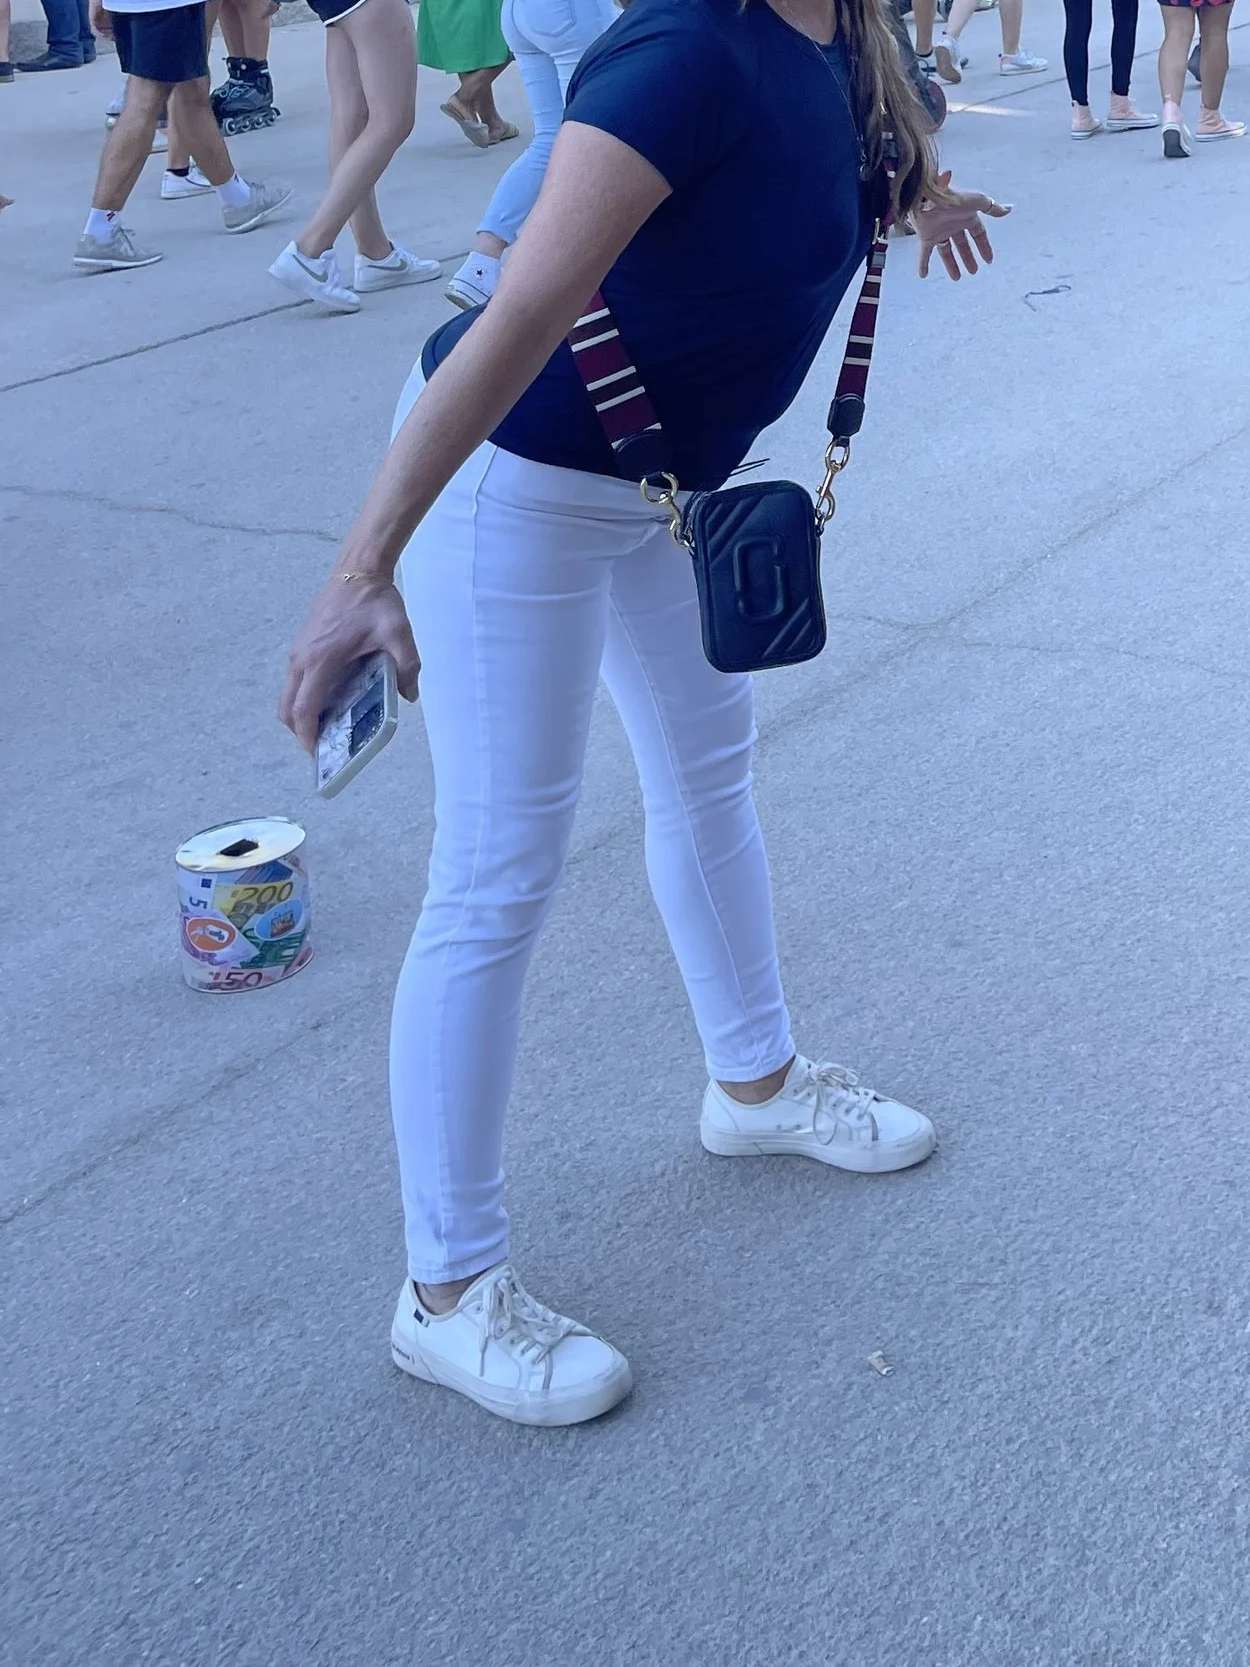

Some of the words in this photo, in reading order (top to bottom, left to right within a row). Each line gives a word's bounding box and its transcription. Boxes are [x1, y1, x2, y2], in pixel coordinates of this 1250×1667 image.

[242, 881, 294, 905] 200
[189, 896, 208, 910] 5
[224, 971, 263, 987] 50
